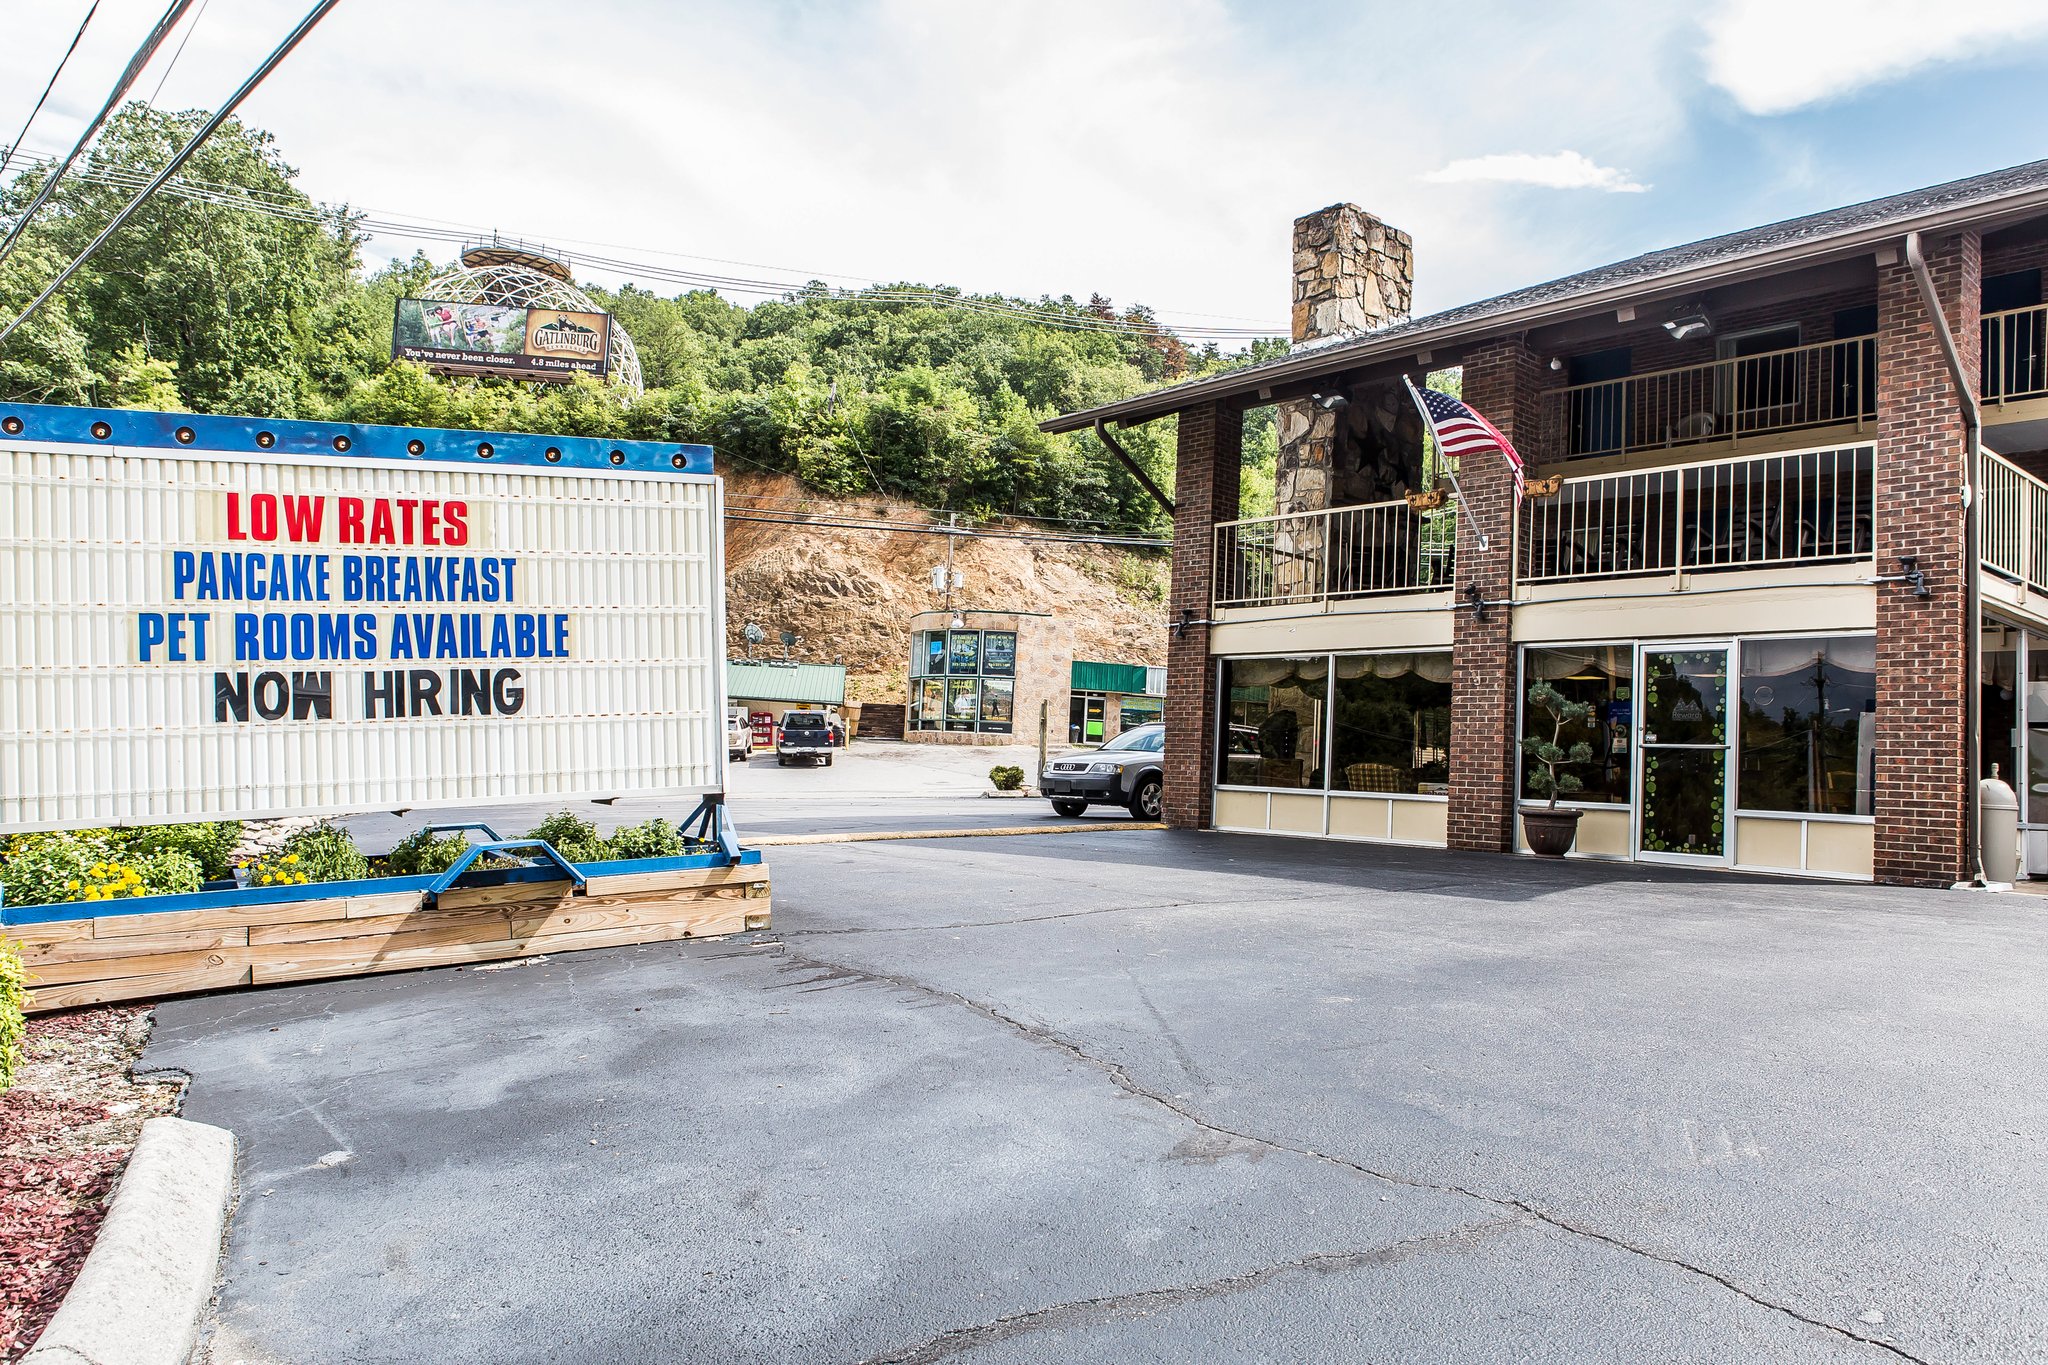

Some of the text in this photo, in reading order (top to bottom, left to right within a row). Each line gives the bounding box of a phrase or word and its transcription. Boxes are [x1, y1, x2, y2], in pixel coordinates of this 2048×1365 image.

[404, 348, 516, 364] You've never been closer.
[531, 358, 597, 370] 4.8 miles ahead
[535, 329, 598, 351] GATLINBURG
[227, 493, 468, 546] LOW RATES
[173, 551, 517, 602] PANCAKE BREAKFAST
[139, 612, 569, 661] PET ROOMS AVAILABLE
[215, 668, 524, 722] NOW HIRING
